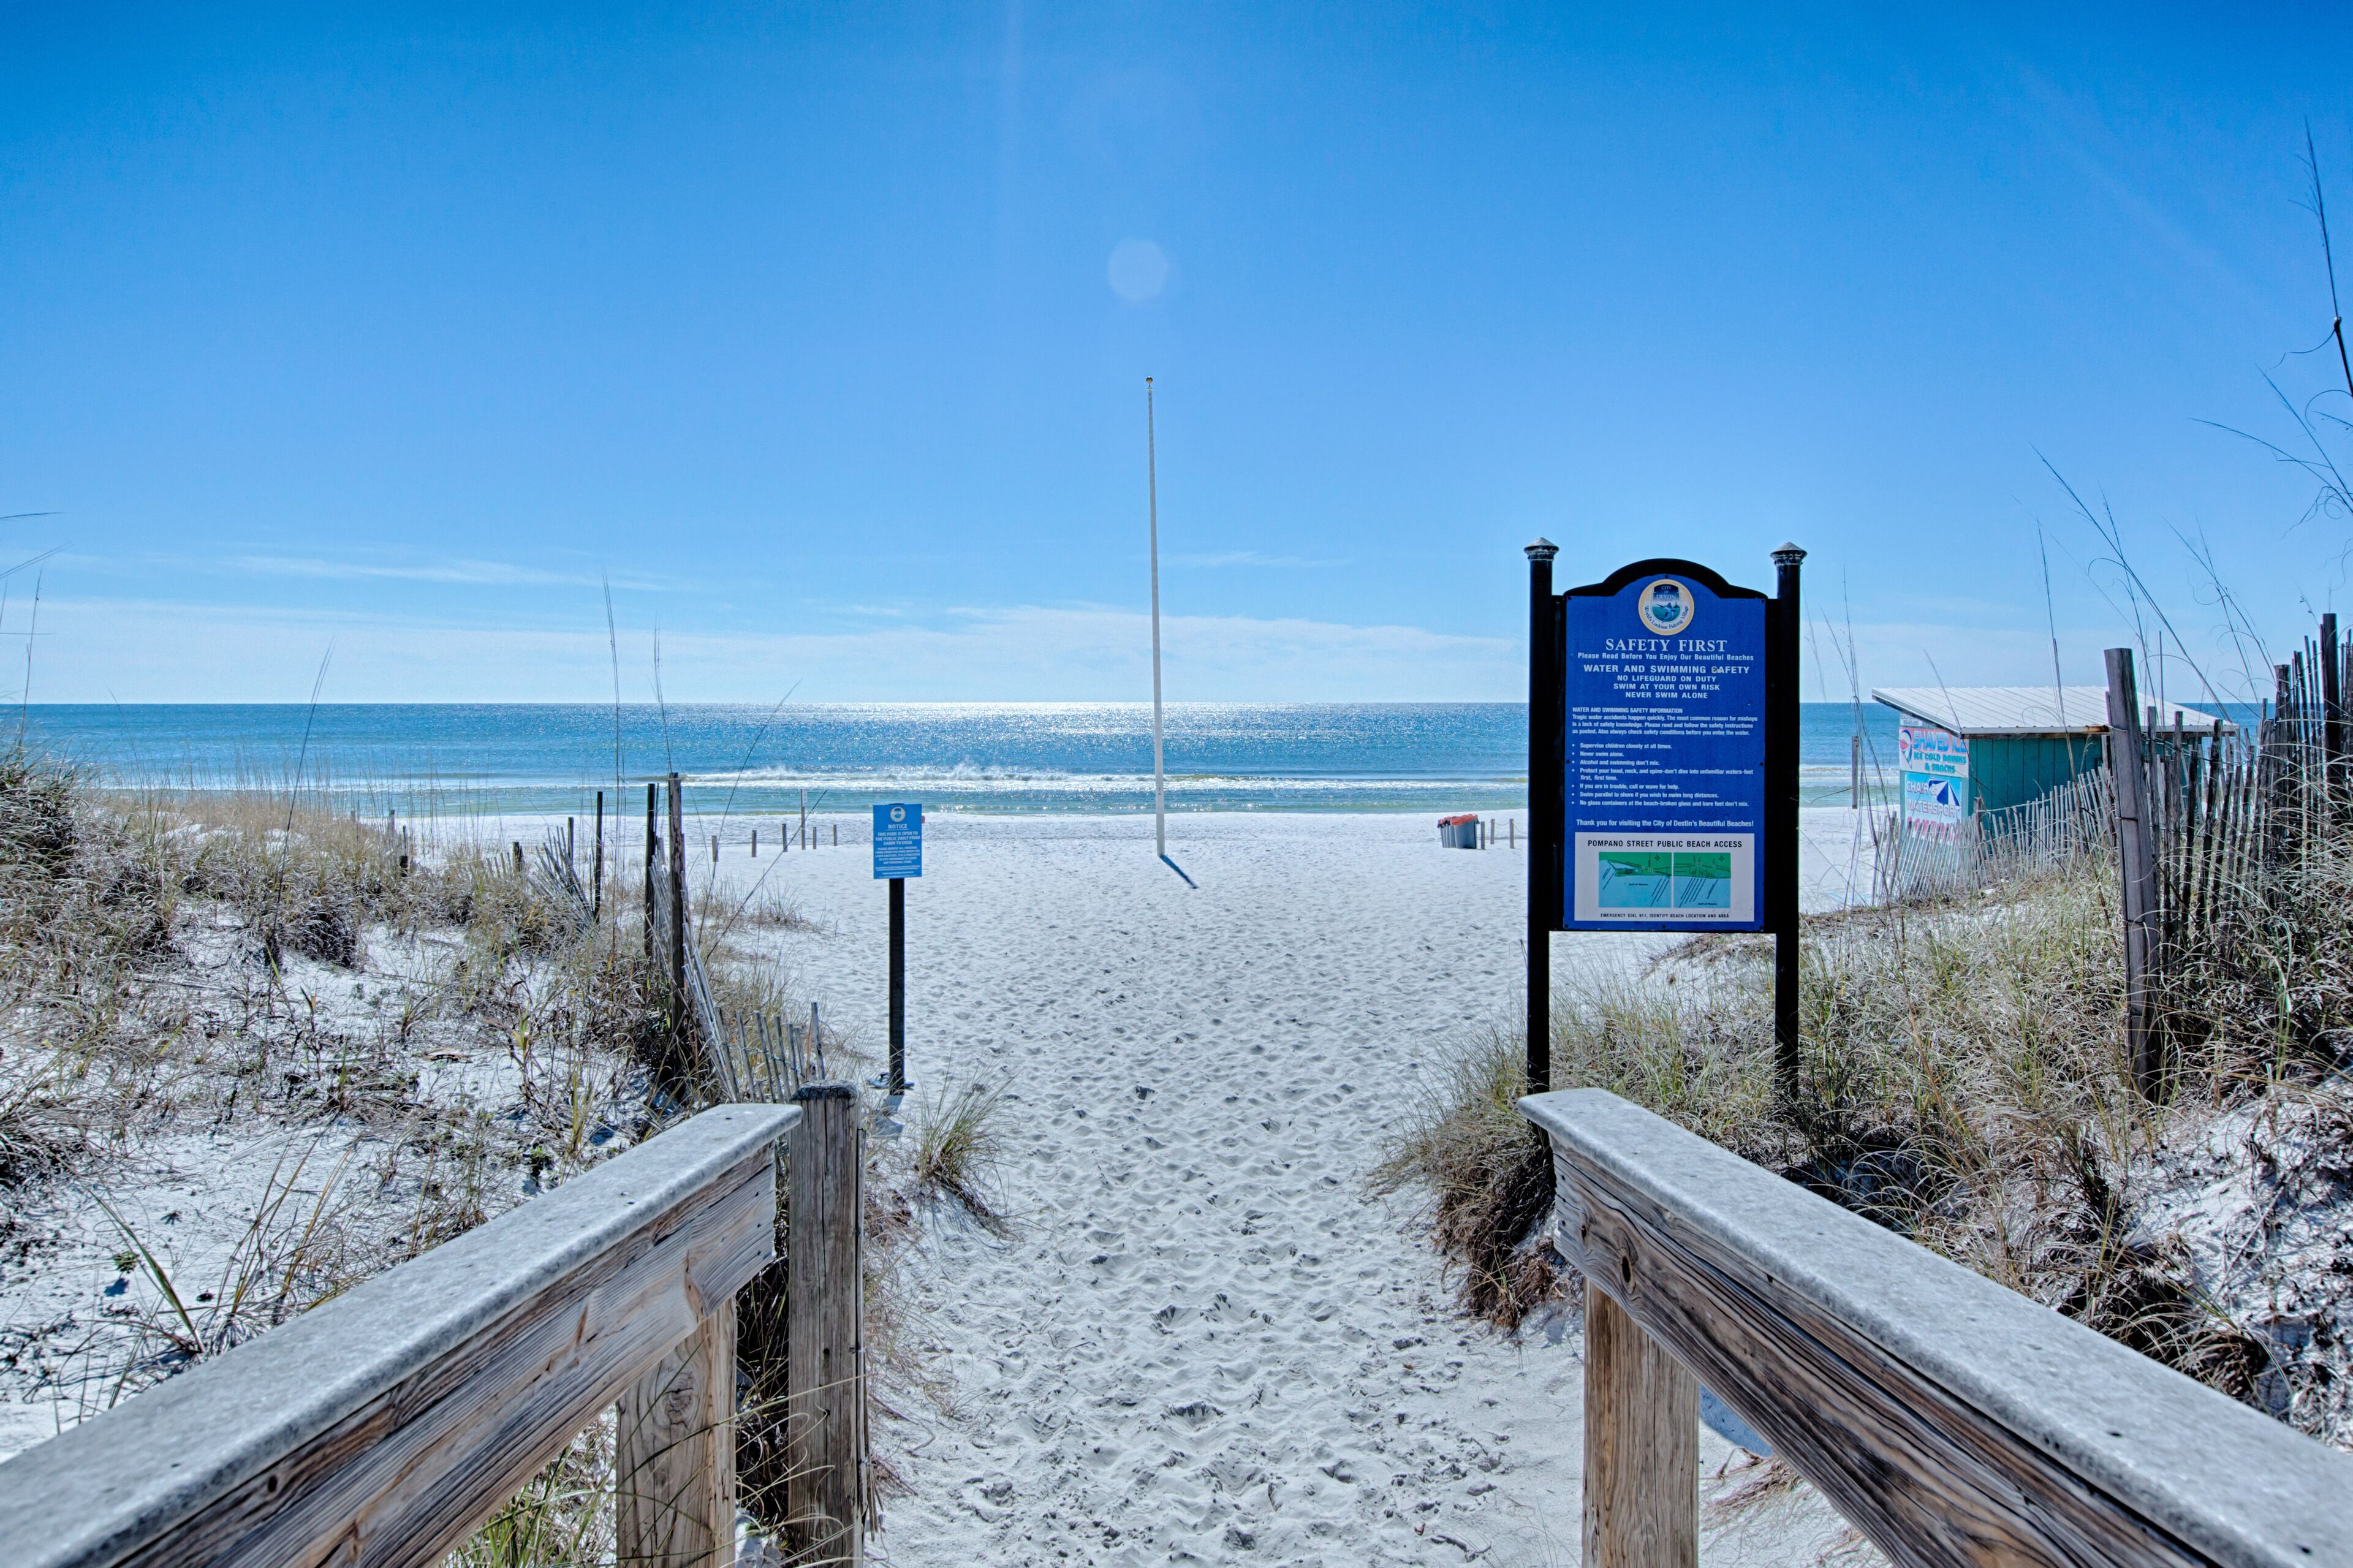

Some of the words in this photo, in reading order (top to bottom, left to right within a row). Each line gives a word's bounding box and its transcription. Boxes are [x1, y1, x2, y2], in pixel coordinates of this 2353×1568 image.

[1606, 638, 1670, 651] SAFETY
[1679, 640, 1727, 652] FIRST
[1913, 730, 1950, 752] SHAVED
[1952, 735, 1966, 754] ICE
[1914, 752, 1923, 760] ICE
[1943, 754, 1966, 765] DRINKS
[1931, 763, 1955, 773] SNACKS
[1906, 781, 1929, 795] CHAIR
[1931, 784, 1937, 796] &
[1906, 799, 1961, 819] WATERSPORT
